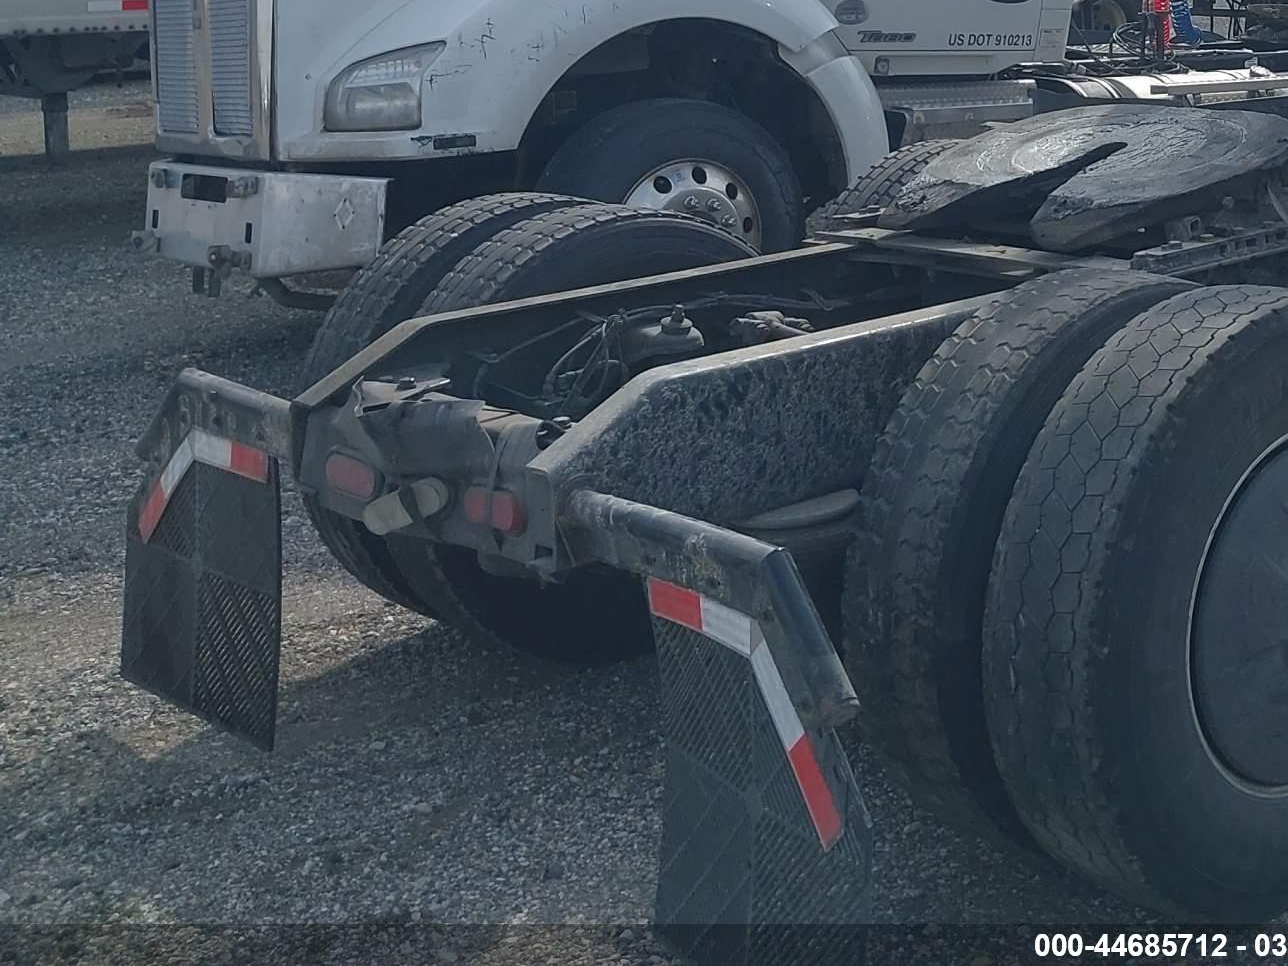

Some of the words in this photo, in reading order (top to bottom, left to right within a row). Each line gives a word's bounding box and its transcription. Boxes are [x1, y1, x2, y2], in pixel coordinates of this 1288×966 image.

[948, 33, 965, 46] US
[967, 33, 993, 46] DOT
[994, 34, 1033, 47] 910213
